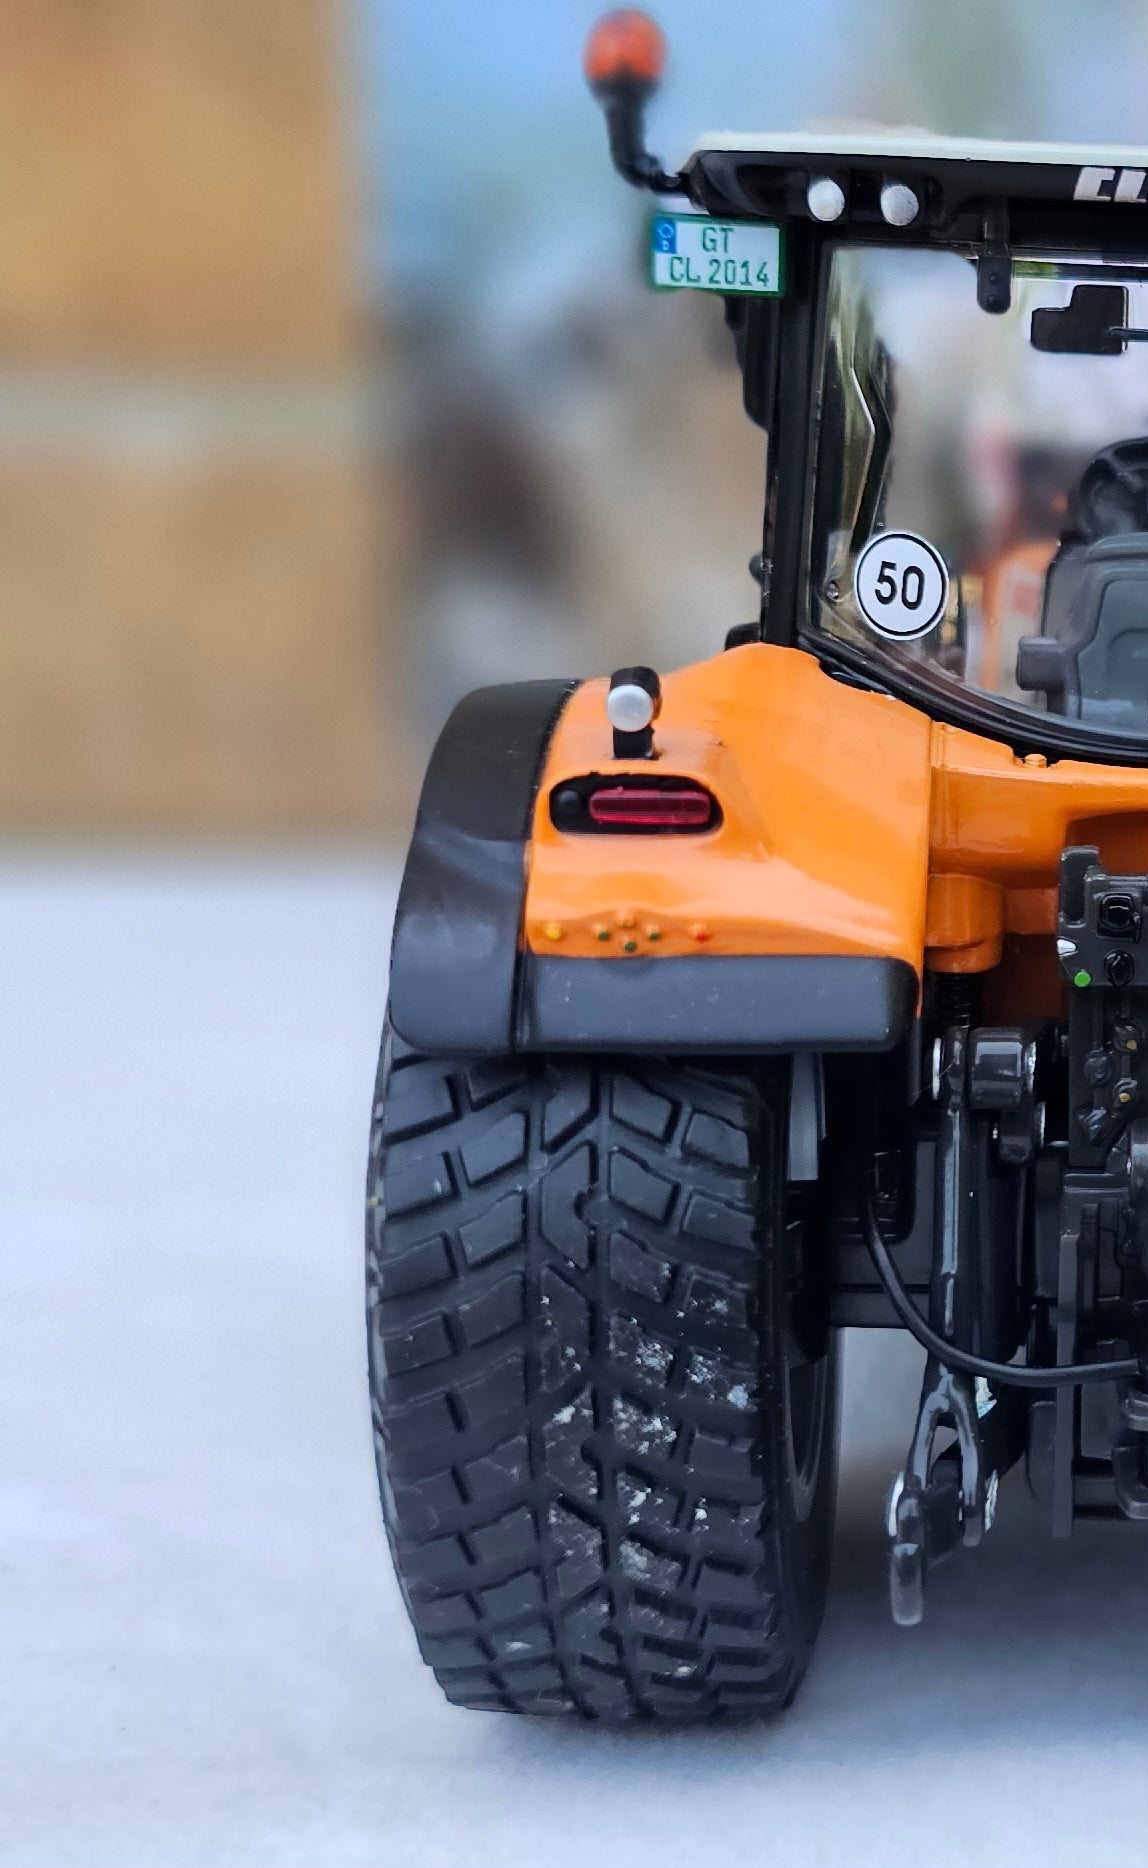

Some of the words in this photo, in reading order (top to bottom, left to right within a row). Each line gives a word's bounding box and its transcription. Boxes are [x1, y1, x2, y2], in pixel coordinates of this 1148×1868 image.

[702, 226, 734, 253] GT
[670, 256, 700, 283] CL
[708, 258, 769, 287] 2014
[875, 561, 925, 610] 50
